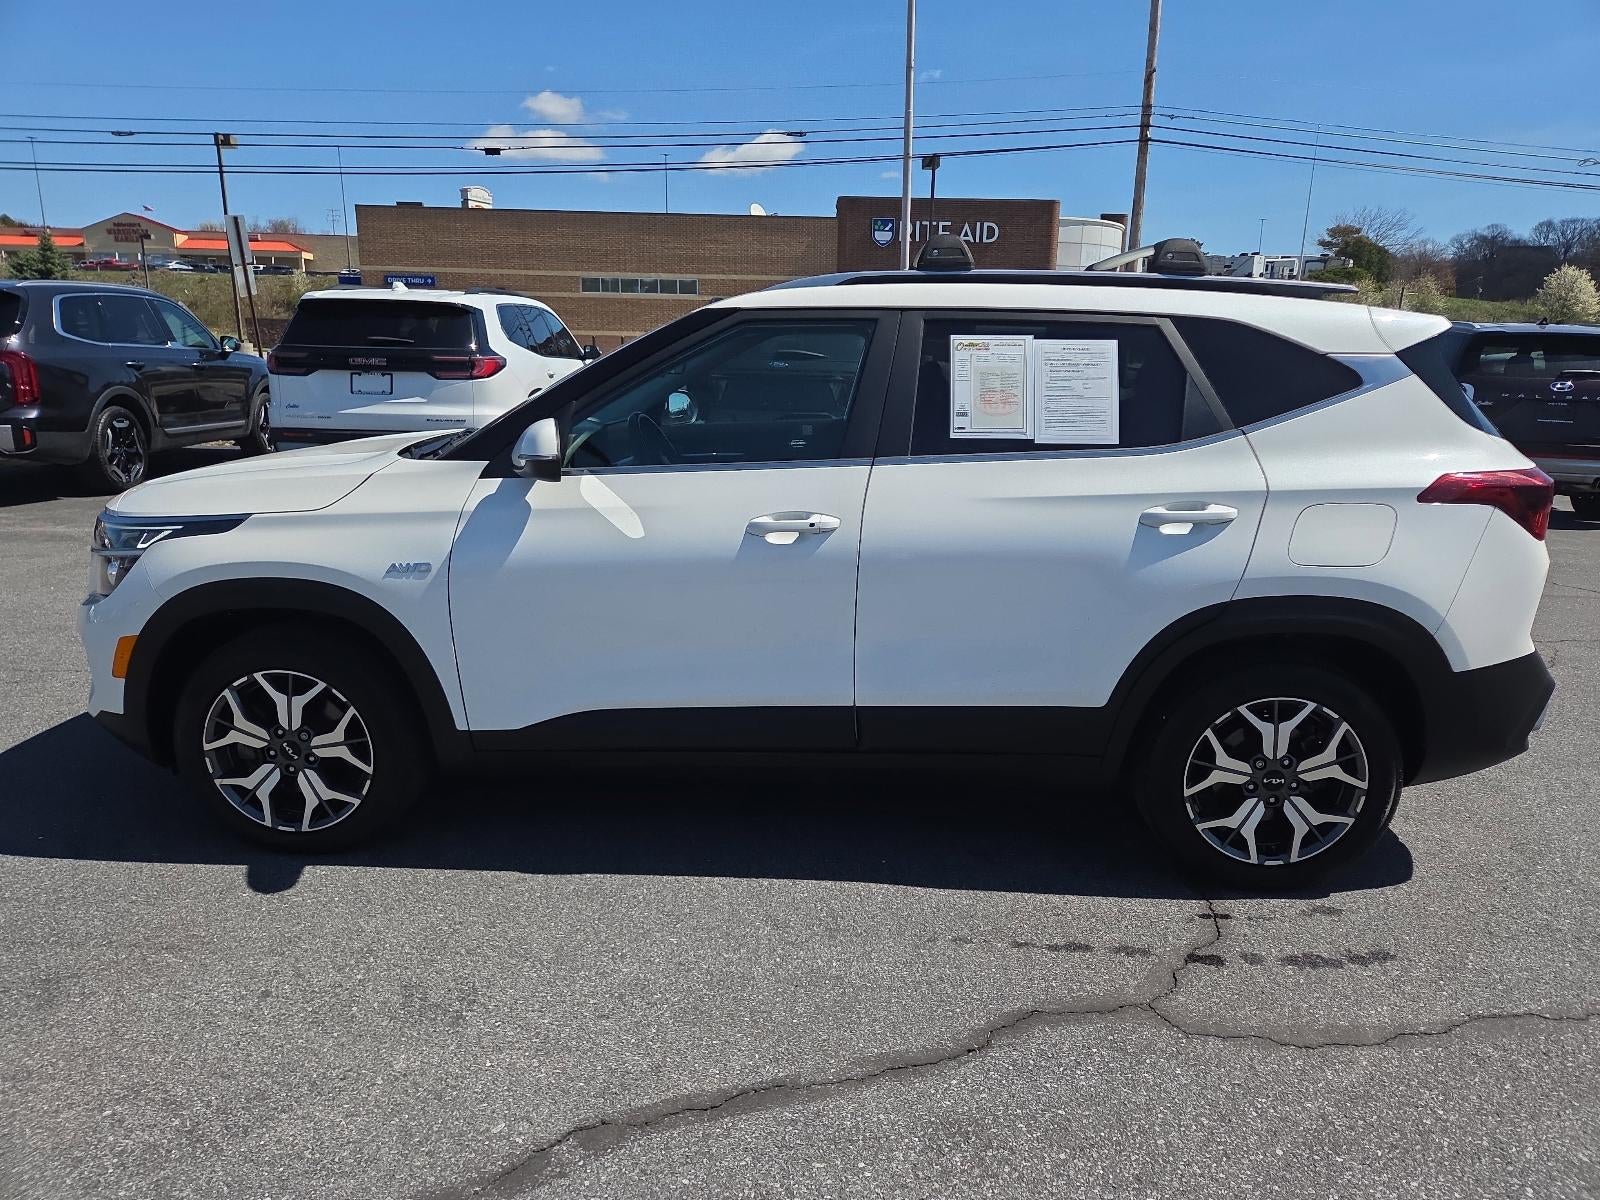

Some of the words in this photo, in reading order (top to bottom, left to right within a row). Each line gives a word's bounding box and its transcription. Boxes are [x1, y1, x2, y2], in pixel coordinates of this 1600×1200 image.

[960, 221, 999, 243] AID
[349, 357, 387, 366] GMC
[381, 562, 432, 581] AWD
